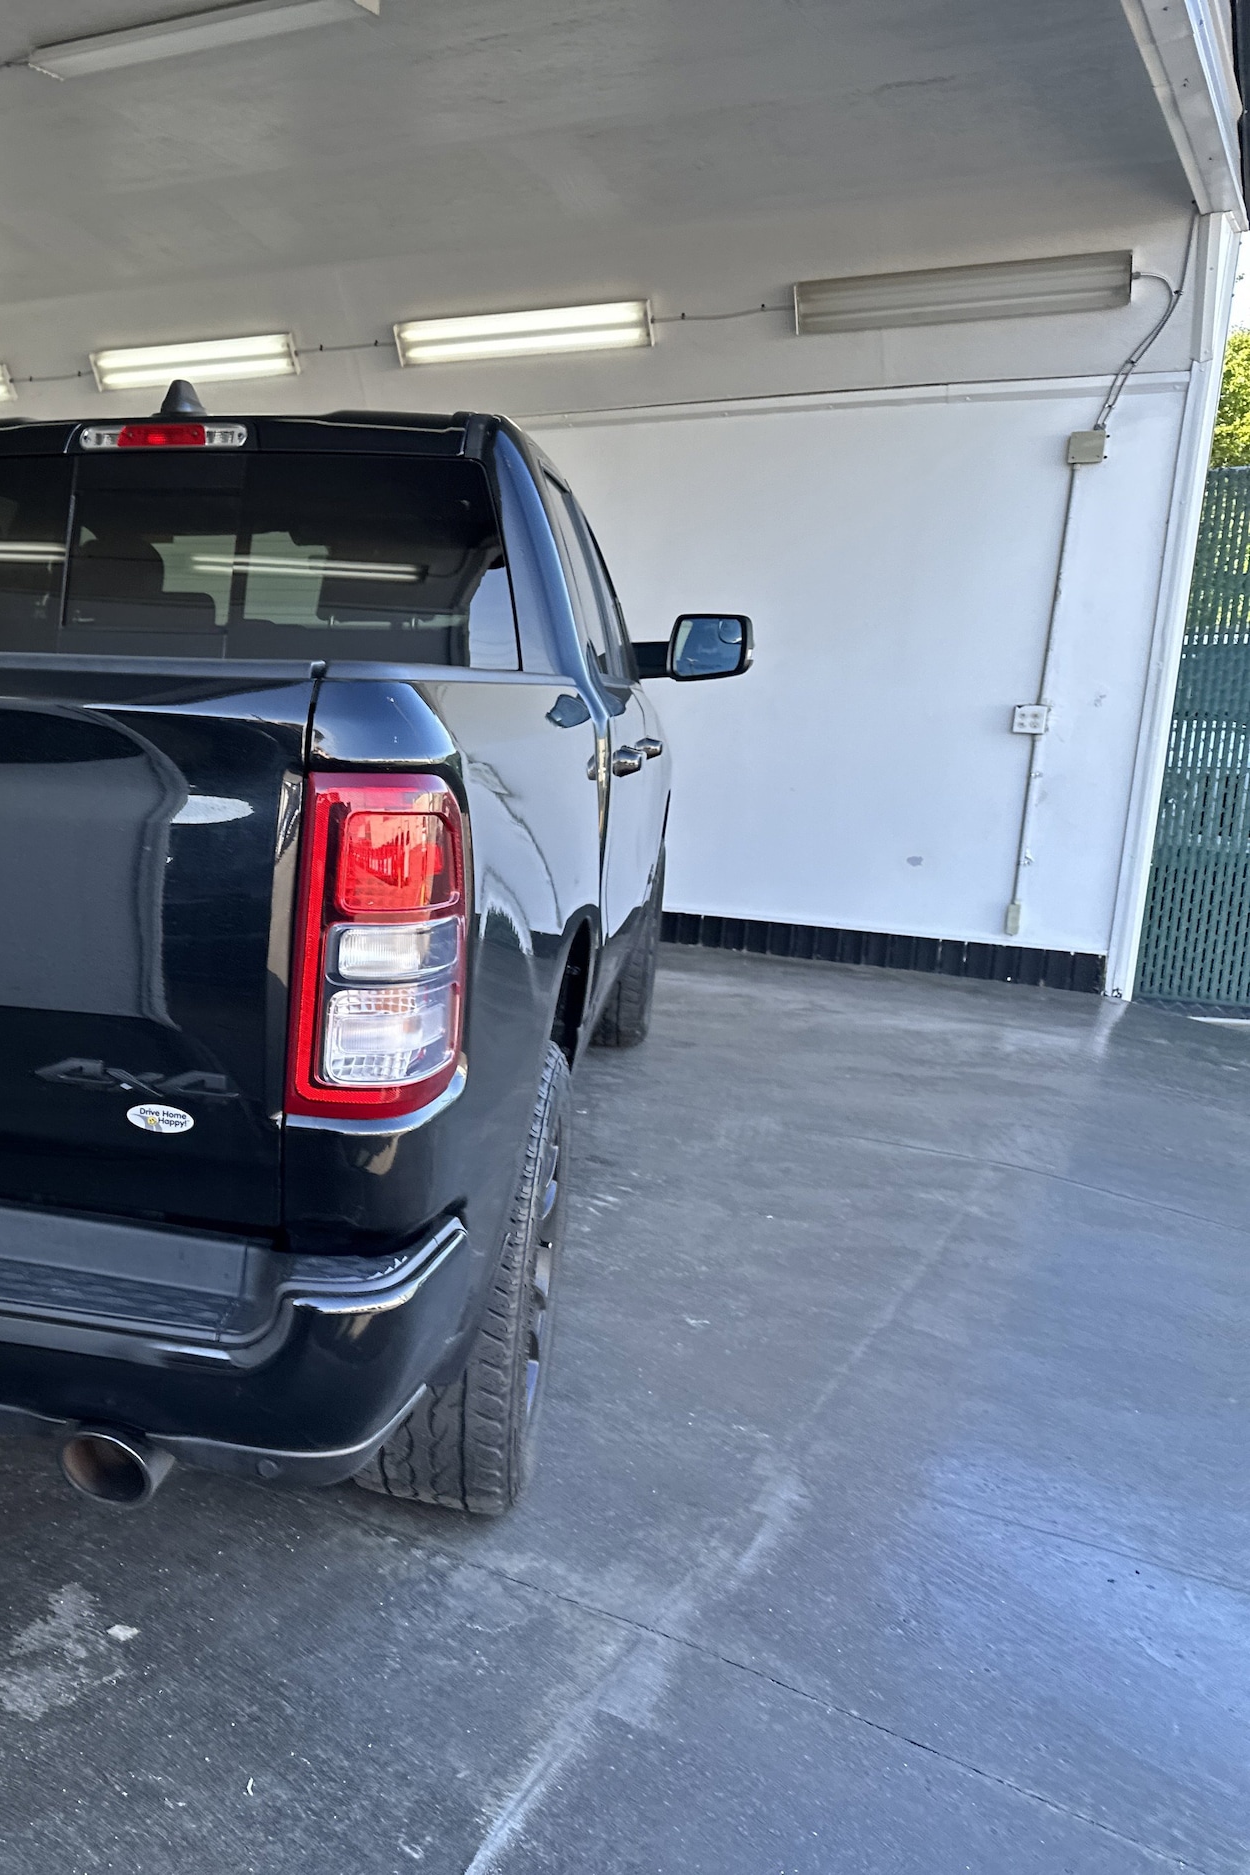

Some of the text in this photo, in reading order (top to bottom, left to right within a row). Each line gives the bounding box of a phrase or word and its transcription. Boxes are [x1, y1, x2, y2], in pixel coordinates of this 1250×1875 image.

[139, 1107, 187, 1120] Drive Home
[158, 1117, 187, 1128] Happy!
